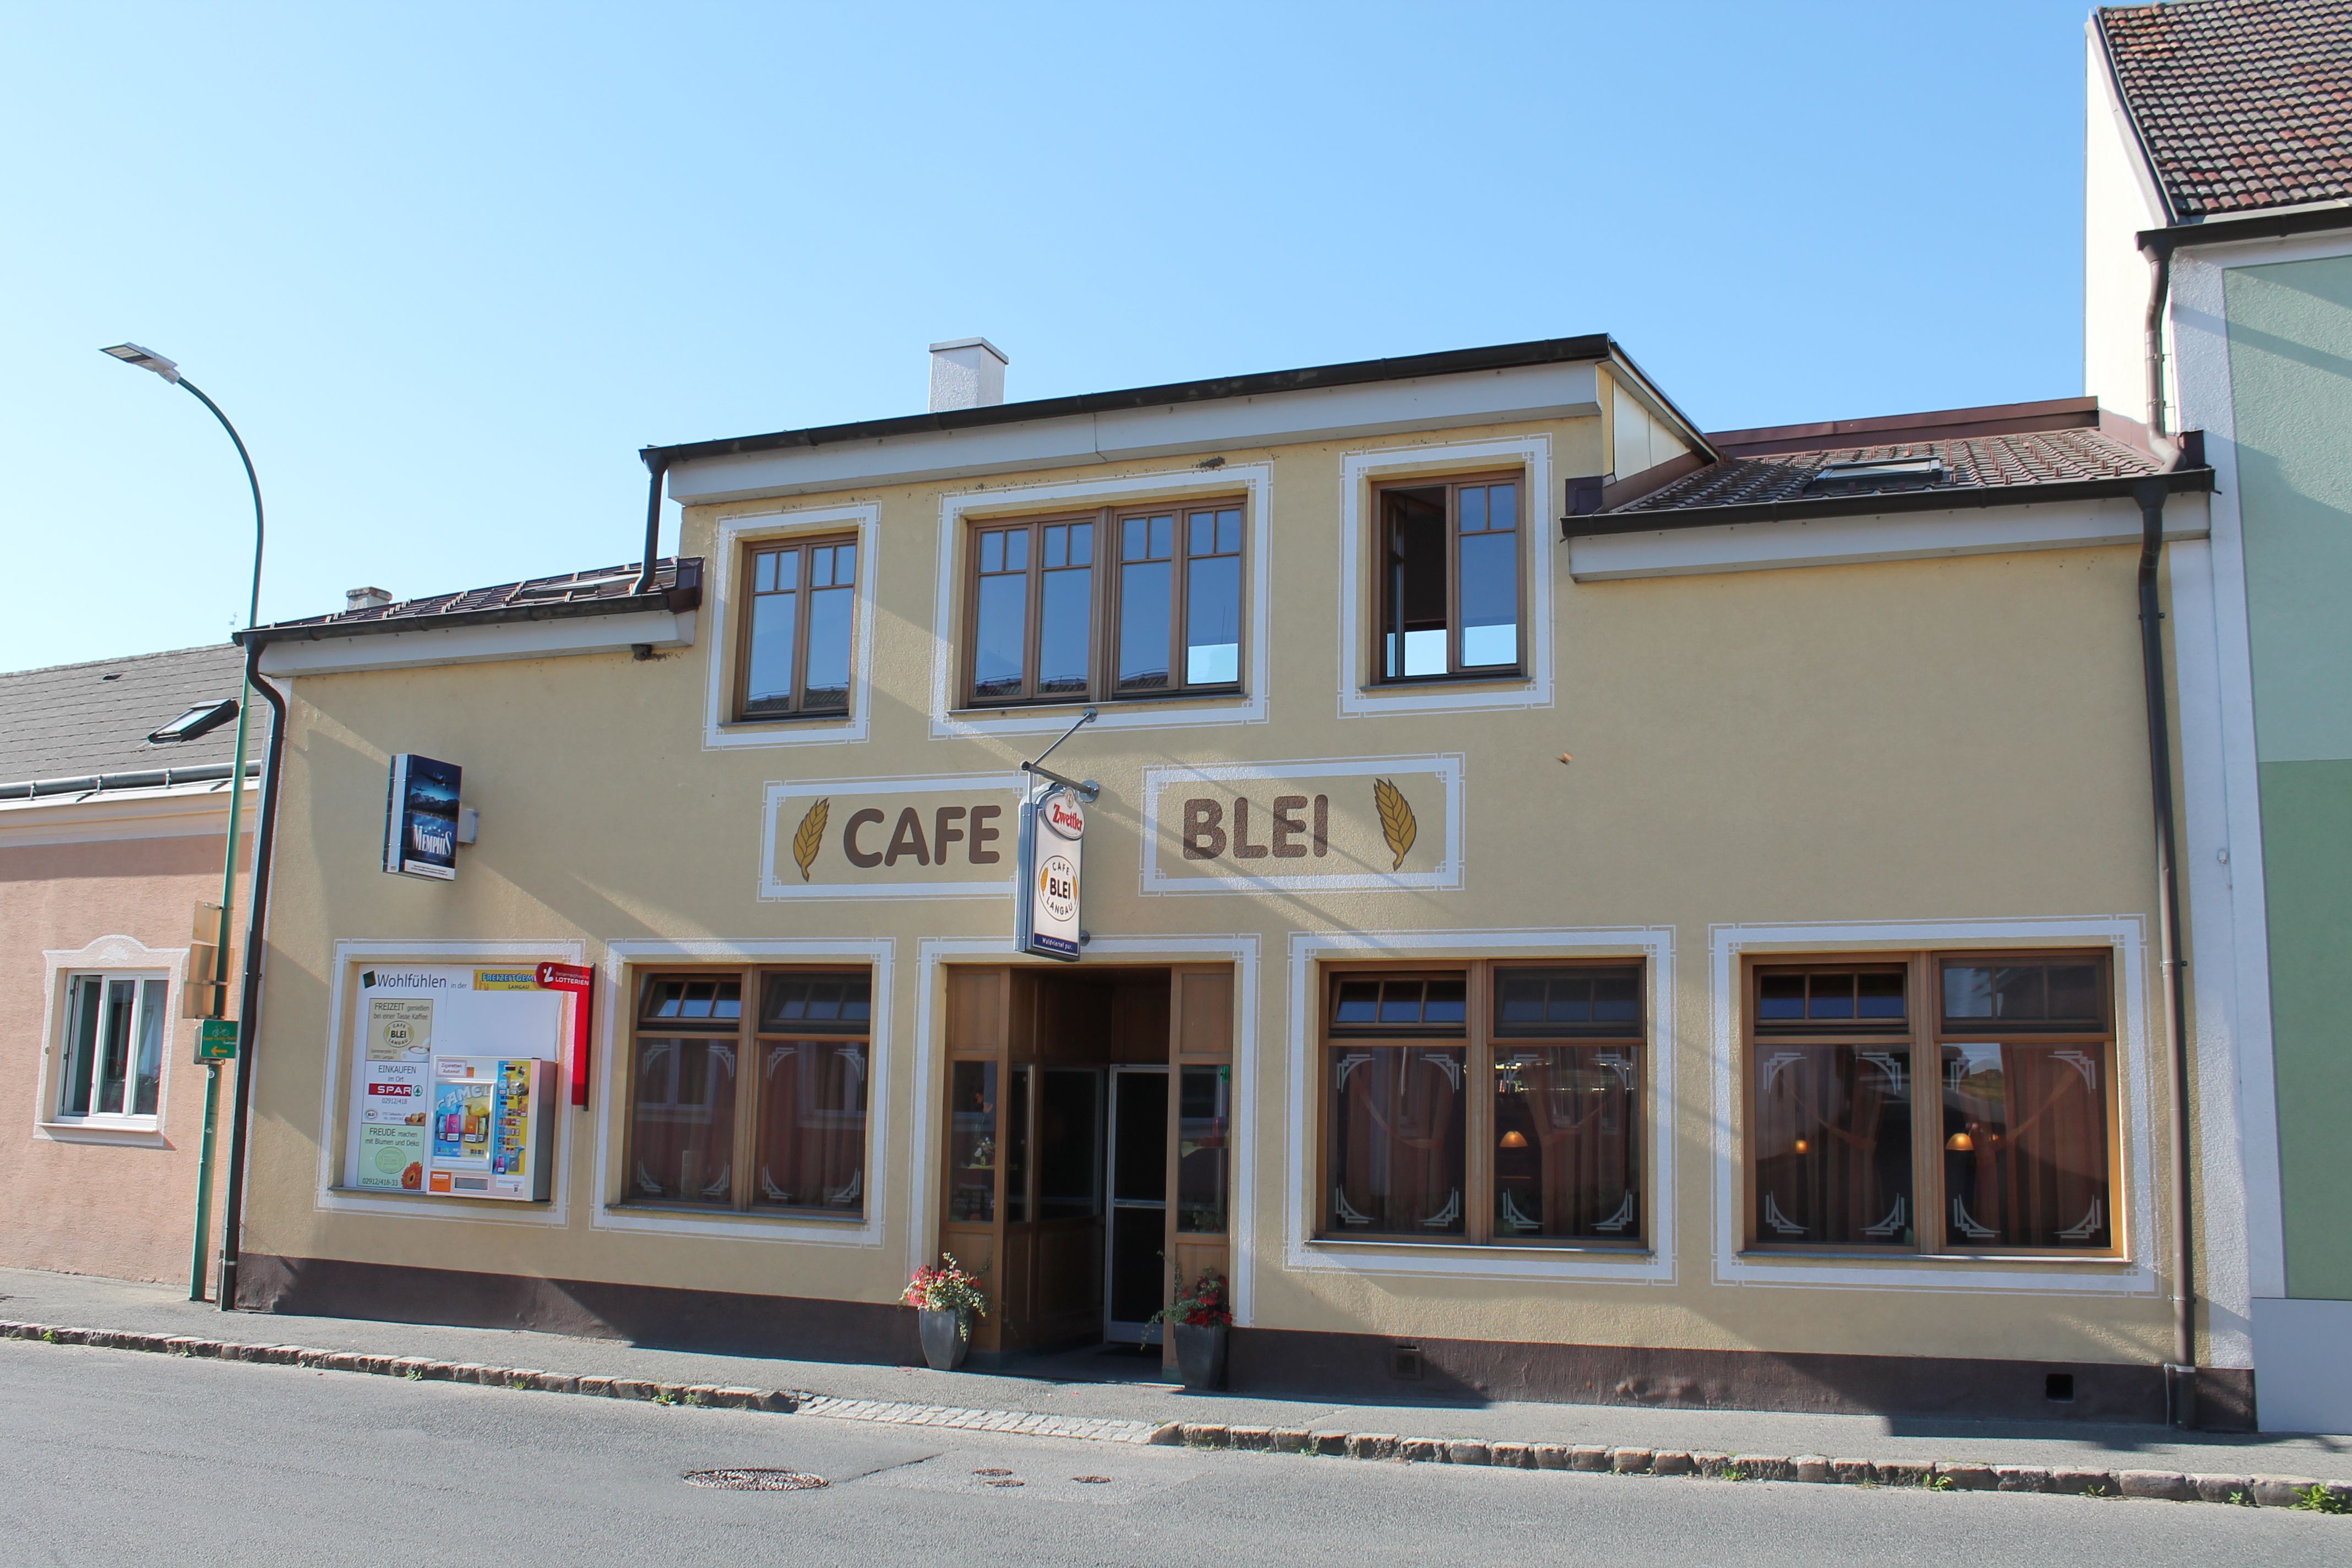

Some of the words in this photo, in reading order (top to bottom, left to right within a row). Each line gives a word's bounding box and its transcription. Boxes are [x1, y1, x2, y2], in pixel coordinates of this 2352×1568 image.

[1053, 803, 1082, 832] Zwettler
[843, 805, 1001, 868] CAFE
[1183, 794, 1328, 861] BLEI
[413, 824, 452, 857] MEMPHIS
[1052, 862, 1070, 875] CAFE
[1049, 877, 1070, 900] BLEI
[1047, 897, 1073, 915] LANGAU
[1042, 937, 1064, 949] Waldviertel
[377, 973, 447, 988] Wohlfühlen
[555, 977, 590, 986] LOTTERIEN
[374, 1003, 405, 1011] FREIZEIT
[390, 1030, 406, 1038] BLEI
[378, 1065, 416, 1074] EINKAUFEN
[377, 1085, 411, 1095] SPAR
[369, 1128, 396, 1136] FREUDE
[362, 1178, 398, 1186] 02912/418-33
